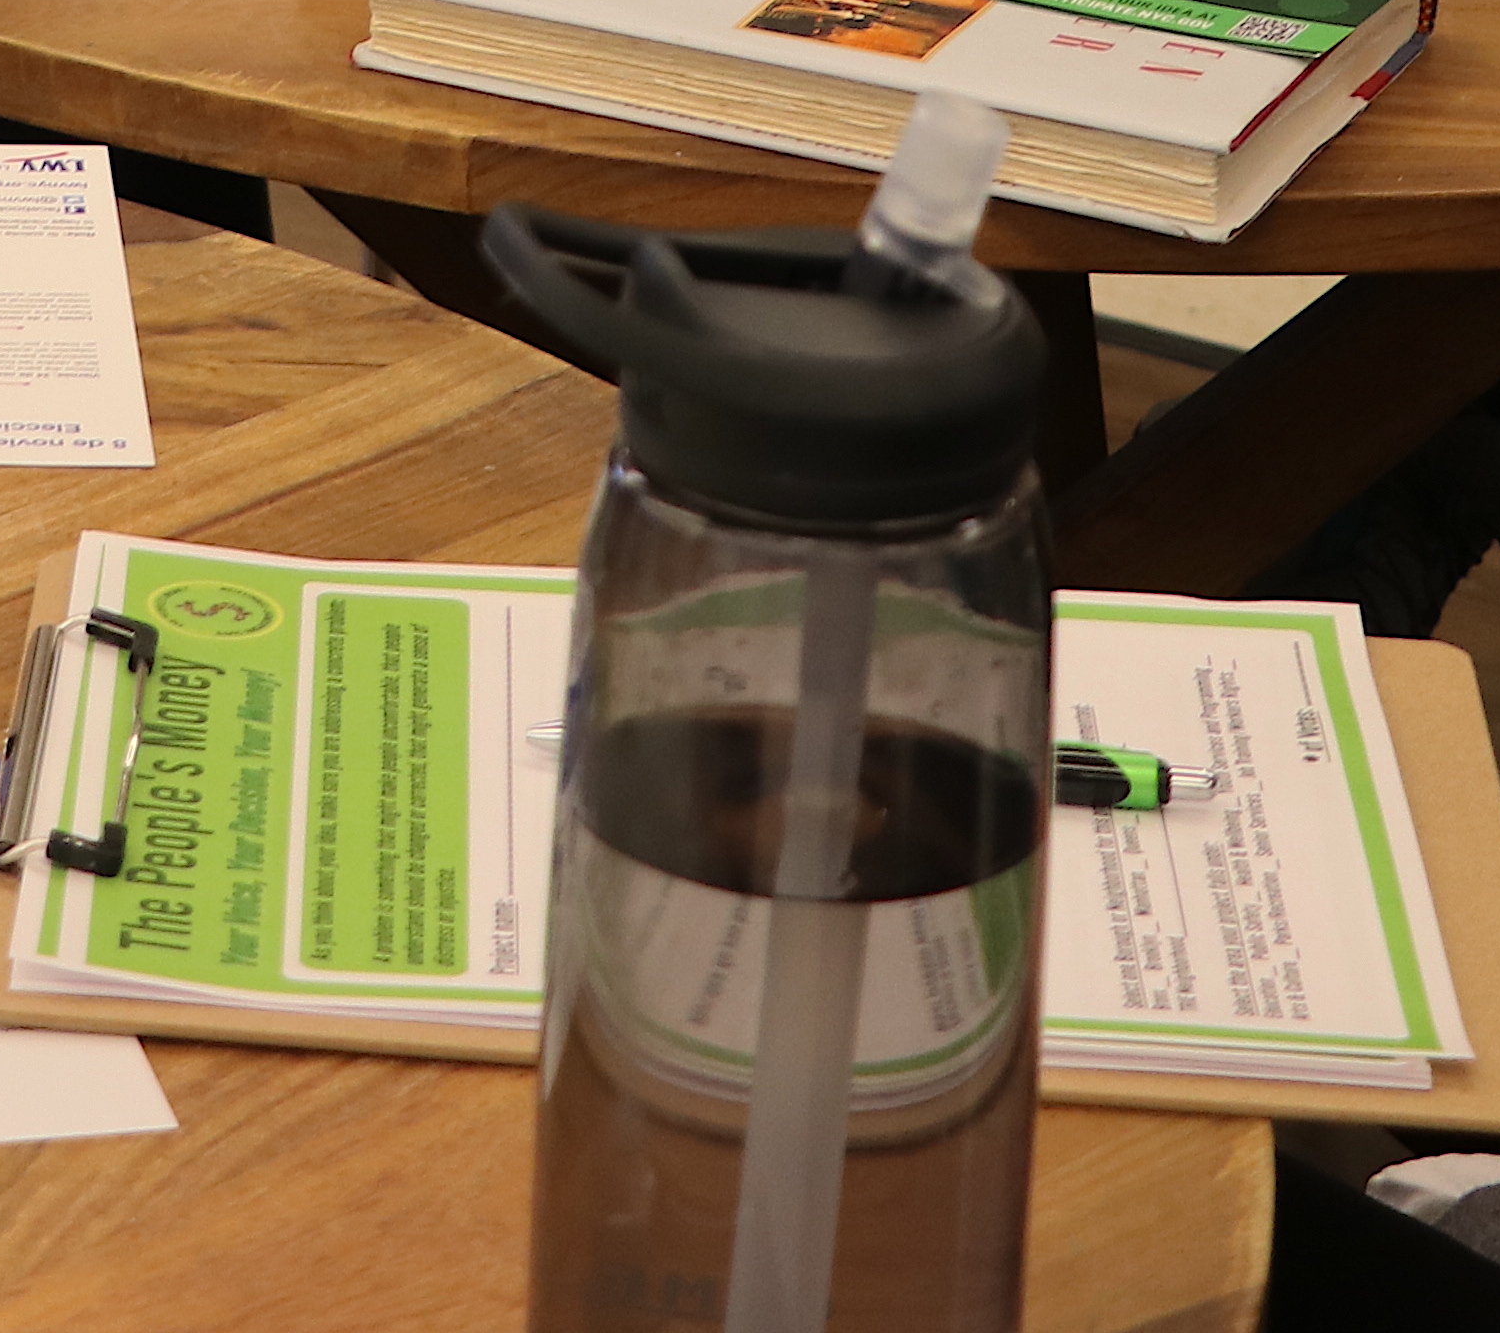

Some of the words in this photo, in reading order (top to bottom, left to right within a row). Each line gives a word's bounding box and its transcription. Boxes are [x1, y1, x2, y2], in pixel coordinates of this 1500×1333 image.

[73, 437, 105, 448] de
[112, 438, 128, 449] 8
[140, 655, 226, 753] Money
[126, 759, 215, 890] People's
[117, 899, 193, 953] The
